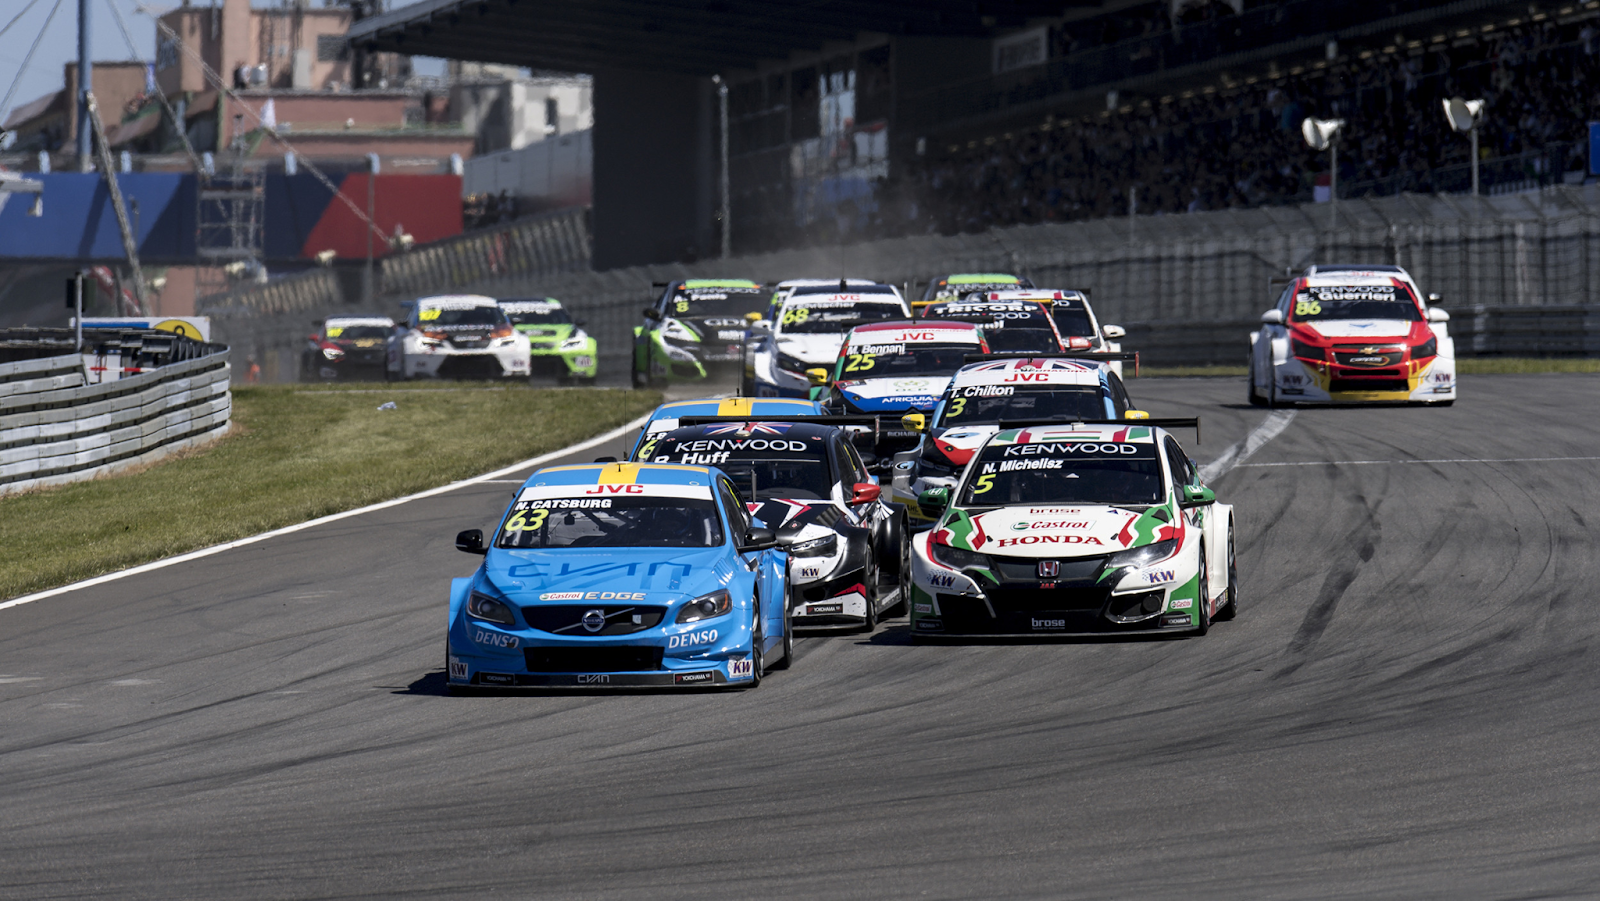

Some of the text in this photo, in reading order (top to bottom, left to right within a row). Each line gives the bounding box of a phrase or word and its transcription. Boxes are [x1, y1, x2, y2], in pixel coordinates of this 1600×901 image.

[1309, 286, 1395, 294] KENWOOD
[1318, 291, 1397, 301] Guerrieri
[828, 294, 861, 302] JVC
[676, 301, 689, 312] 8
[934, 303, 1039, 314] TRICORP
[1295, 301, 1322, 315] 86
[782, 308, 810, 324] 68
[895, 332, 935, 341] JVC
[846, 343, 906, 355] M. Bennani
[845, 353, 877, 372] 25
[1004, 373, 1049, 382] JVC
[950, 386, 1014, 399] T. Chilton
[882, 396, 933, 404] AFRIQUIA
[945, 397, 967, 418] 3
[638, 440, 659, 459] 6
[675, 438, 808, 453] KENWOOD
[1004, 442, 1138, 457] KENWOOD
[681, 451, 731, 465] Huff
[982, 458, 1064, 475] N. Michelisz
[586, 484, 644, 494] JVC
[974, 474, 997, 494] 5
[505, 508, 549, 531] 63
[1031, 520, 1090, 530] Castrol
[997, 535, 1105, 549] HONDA
[802, 568, 820, 577] KW
[1150, 569, 1176, 583] KW
[930, 574, 956, 587] KW
[550, 591, 648, 601] Castrol EDGE
[1031, 617, 1066, 627] brose
[475, 630, 520, 649] DENSO
[668, 629, 718, 649] DENSO
[451, 662, 468, 676] KW
[733, 661, 752, 674] KW
[682, 673, 706, 681] YOKOHAMA
